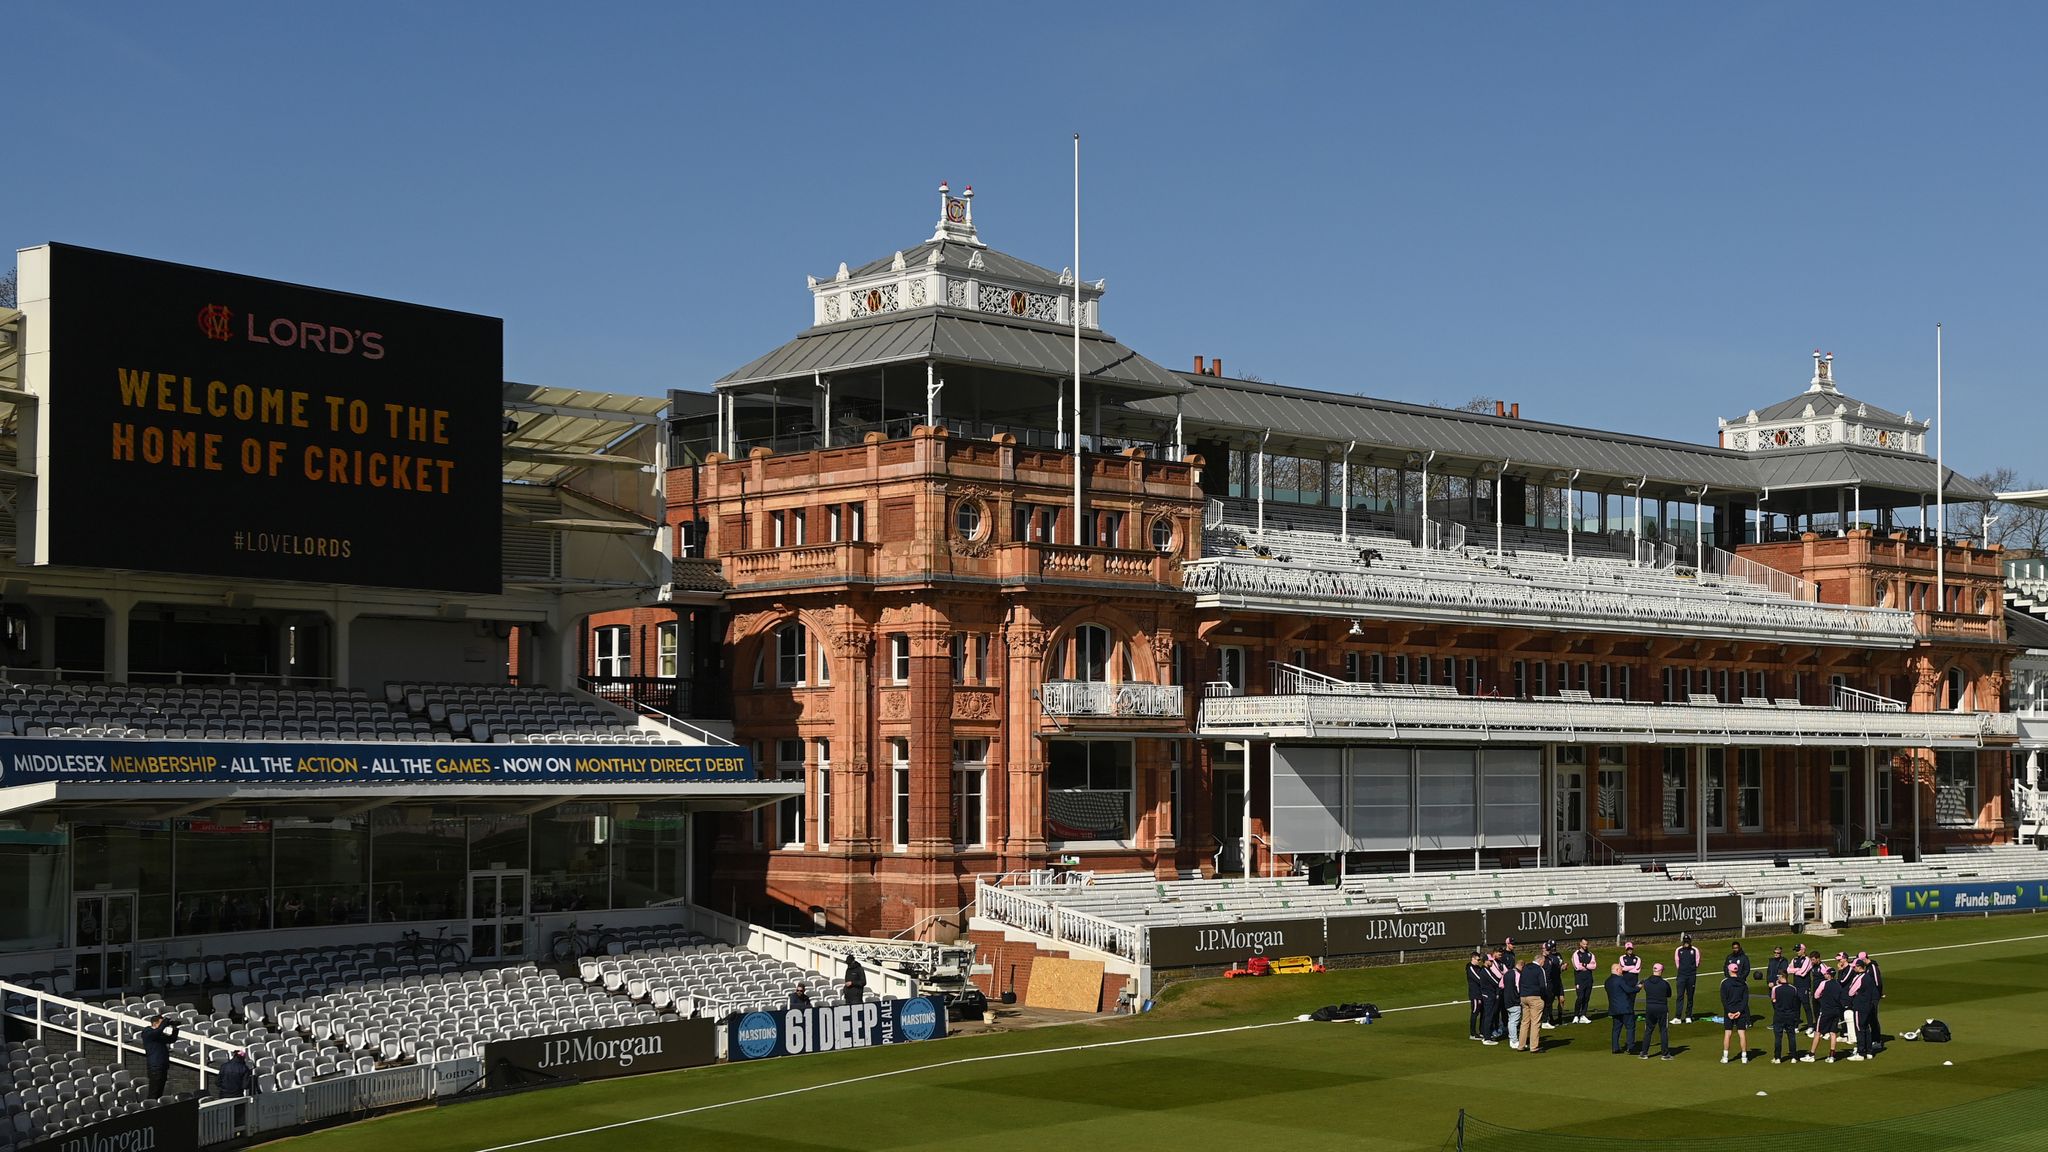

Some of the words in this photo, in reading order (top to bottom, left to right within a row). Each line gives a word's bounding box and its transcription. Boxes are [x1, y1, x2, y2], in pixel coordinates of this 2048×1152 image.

[247, 313, 385, 360] LORD'S
[118, 367, 309, 428] WELCOME
[325, 396, 369, 434] TO
[385, 403, 449, 445] THE
[112, 422, 223, 470] HOME
[241, 437, 288, 477] OF
[304, 445, 455, 494] CRICKET
[234, 531, 351, 558] #LOVELORDS
[14, 754, 107, 772] MIDDLESEX
[110, 756, 217, 773] MEMBERSHIP
[230, 757, 260, 773] ALL
[261, 757, 294, 773] THE
[297, 757, 358, 773] ACTION
[371, 758, 400, 773] ALL
[401, 758, 433, 774] THE
[435, 758, 491, 773] GAMES
[502, 757, 543, 773] NOW
[546, 757, 571, 773] ON
[575, 758, 647, 773] MONTHLY
[650, 758, 702, 773] DIRECT
[705, 758, 744, 772] DEBIT
[1518, 911, 1589, 934] J.P.Morgan
[1653, 901, 1717, 925] J.P.Morgan
[1195, 928, 1284, 954] J.P.Morgan
[1365, 918, 1447, 944] J.P.Morgan
[881, 1000, 892, 1018] ALE
[901, 1012, 936, 1026] MARSTON'S
[785, 1008, 813, 1054] 61
[819, 1003, 877, 1051] DEEP
[881, 1020, 893, 1045] PALE
[538, 1035, 663, 1068] J.P.Morgan
[61, 1125, 155, 1152] Morgan
